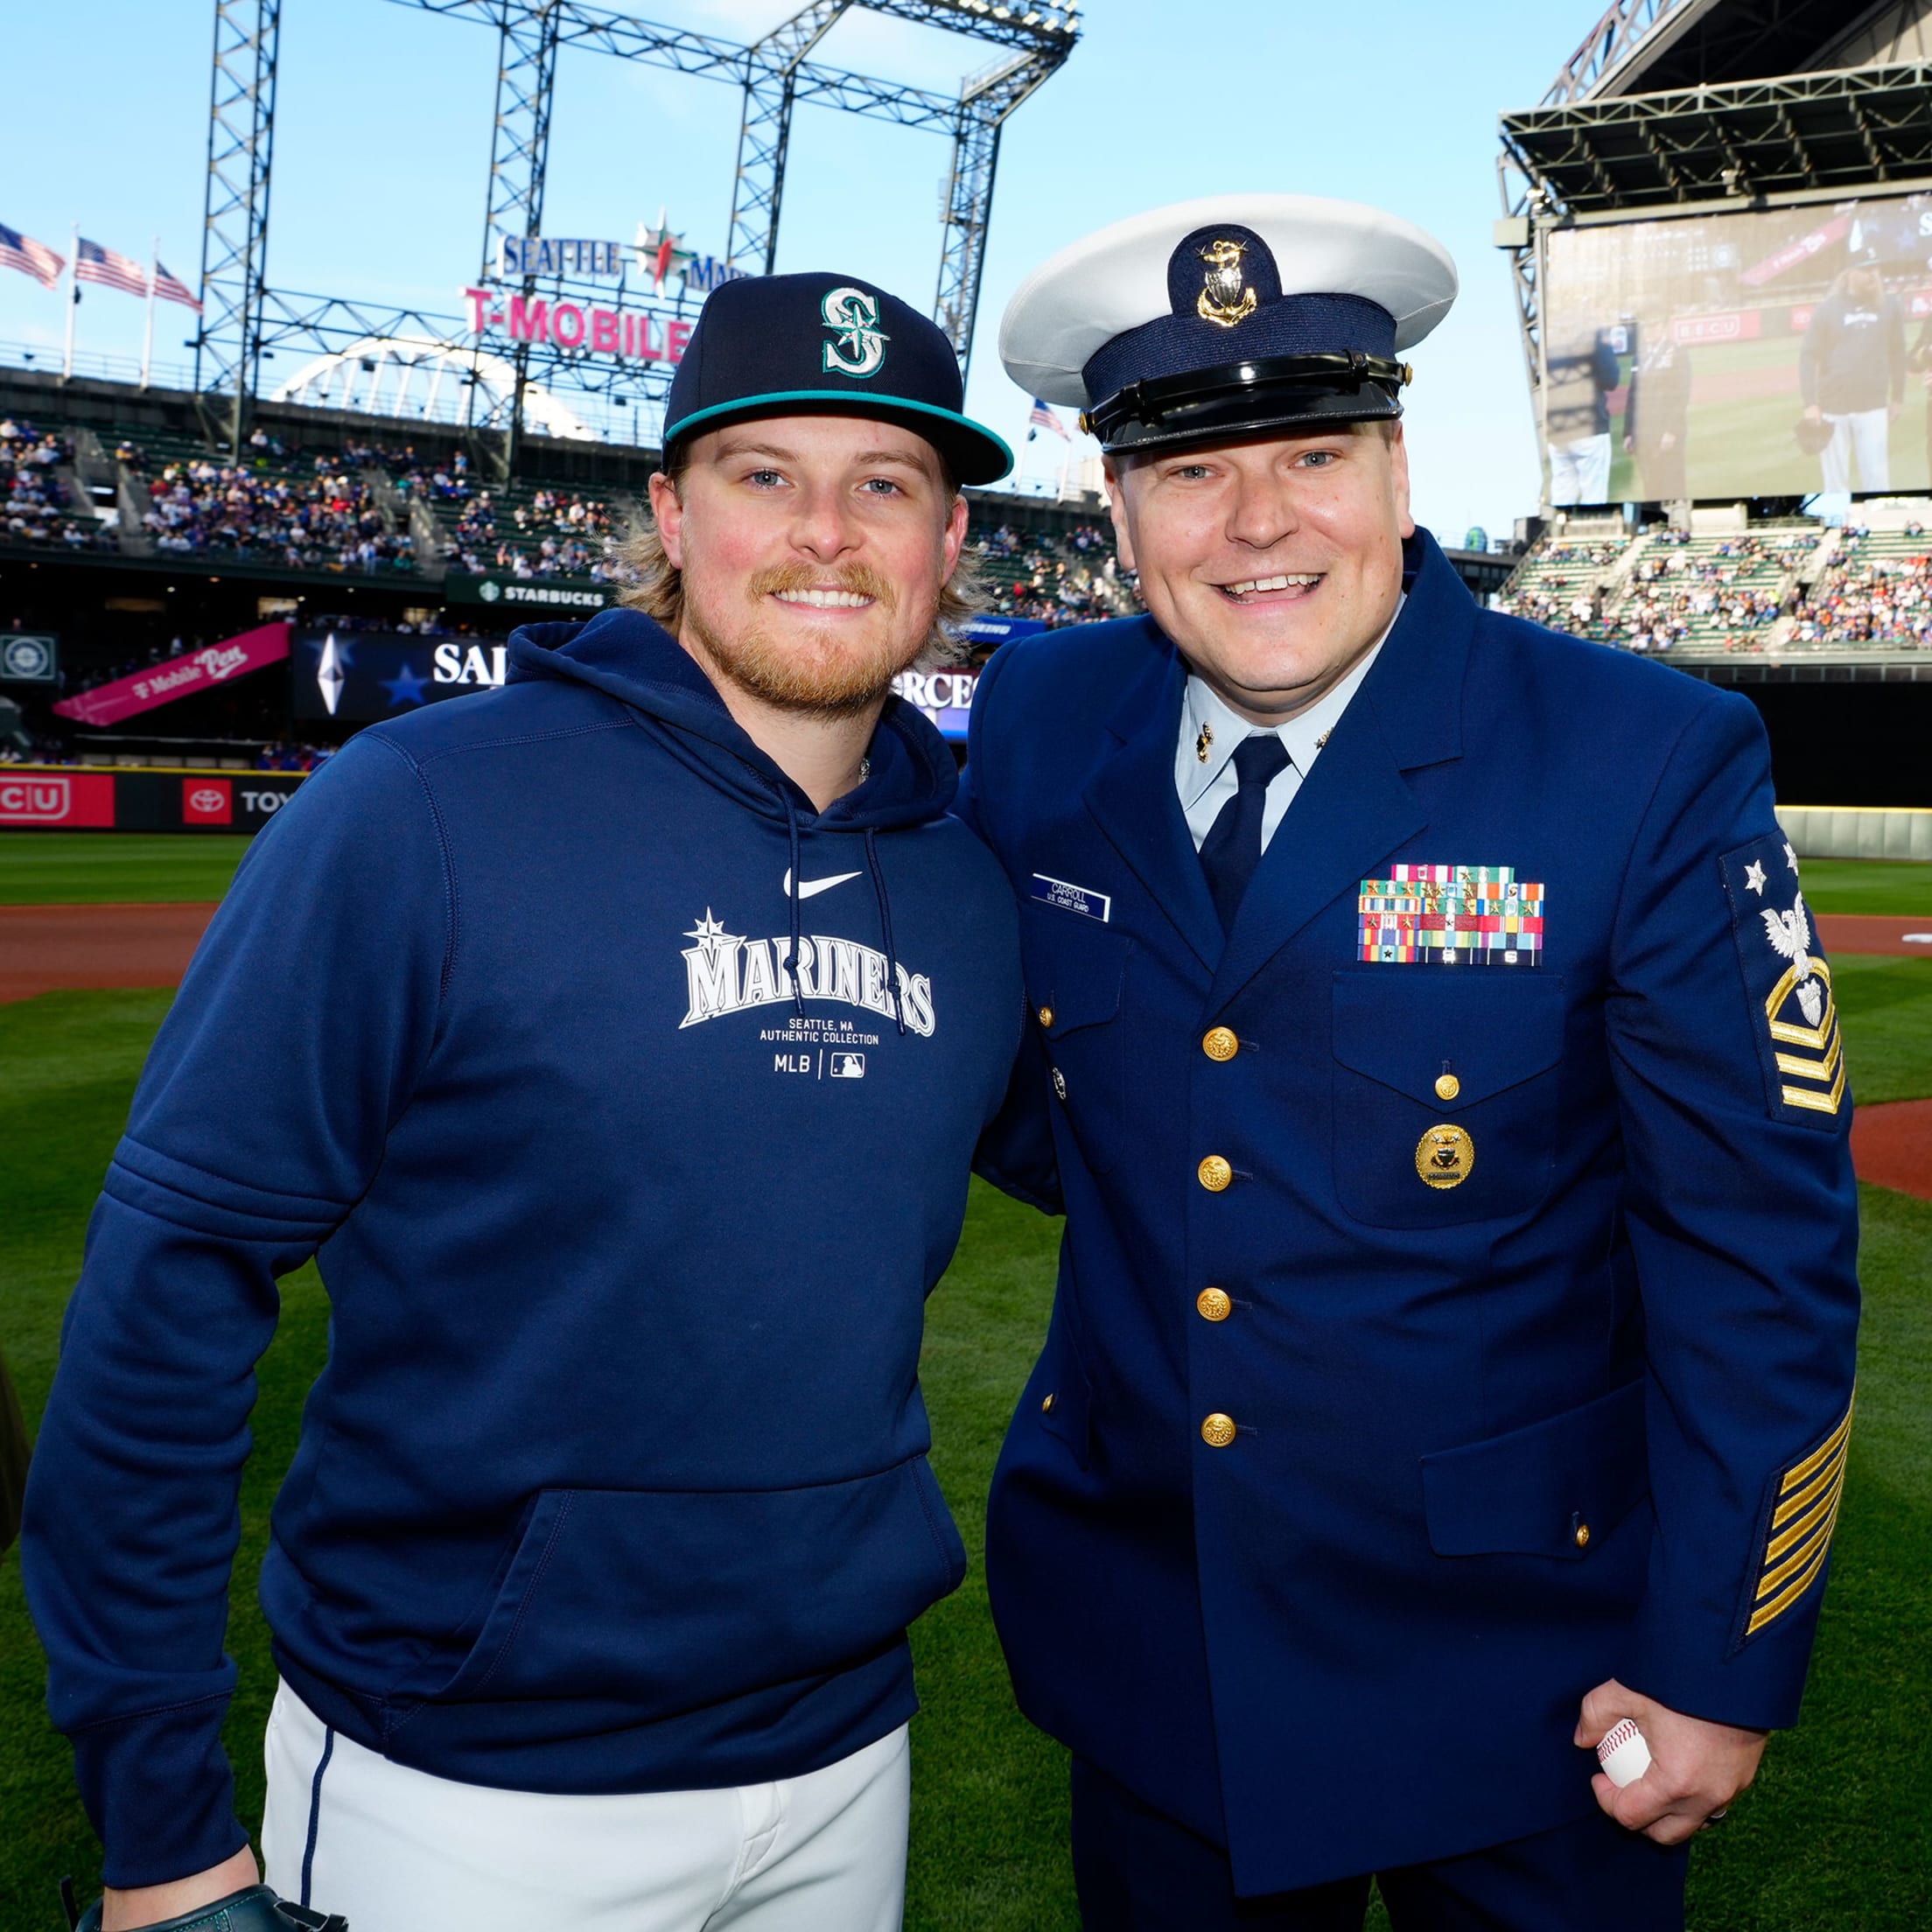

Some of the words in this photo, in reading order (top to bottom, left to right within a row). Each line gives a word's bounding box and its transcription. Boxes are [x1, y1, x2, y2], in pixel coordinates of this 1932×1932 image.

[500, 234, 620, 276] SEATTLE
[460, 286, 692, 364] T-MOBILE
[504, 585, 604, 607] STARBUCKS
[149, 666, 202, 695] Mobile
[193, 646, 248, 679] Pen
[891, 671, 979, 710] RCE
[1052, 882, 1086, 903] CARROLL
[1057, 896, 1073, 907] COAST
[1073, 901, 1089, 913] GUARD
[679, 934, 935, 1038] MARINERS
[789, 1018, 837, 1032] SEATTLE,
[840, 1020, 853, 1032] WA
[760, 1030, 819, 1043] AUTHENTIC
[822, 1032, 879, 1046] COLLECTION
[774, 1054, 810, 1073] MLB
